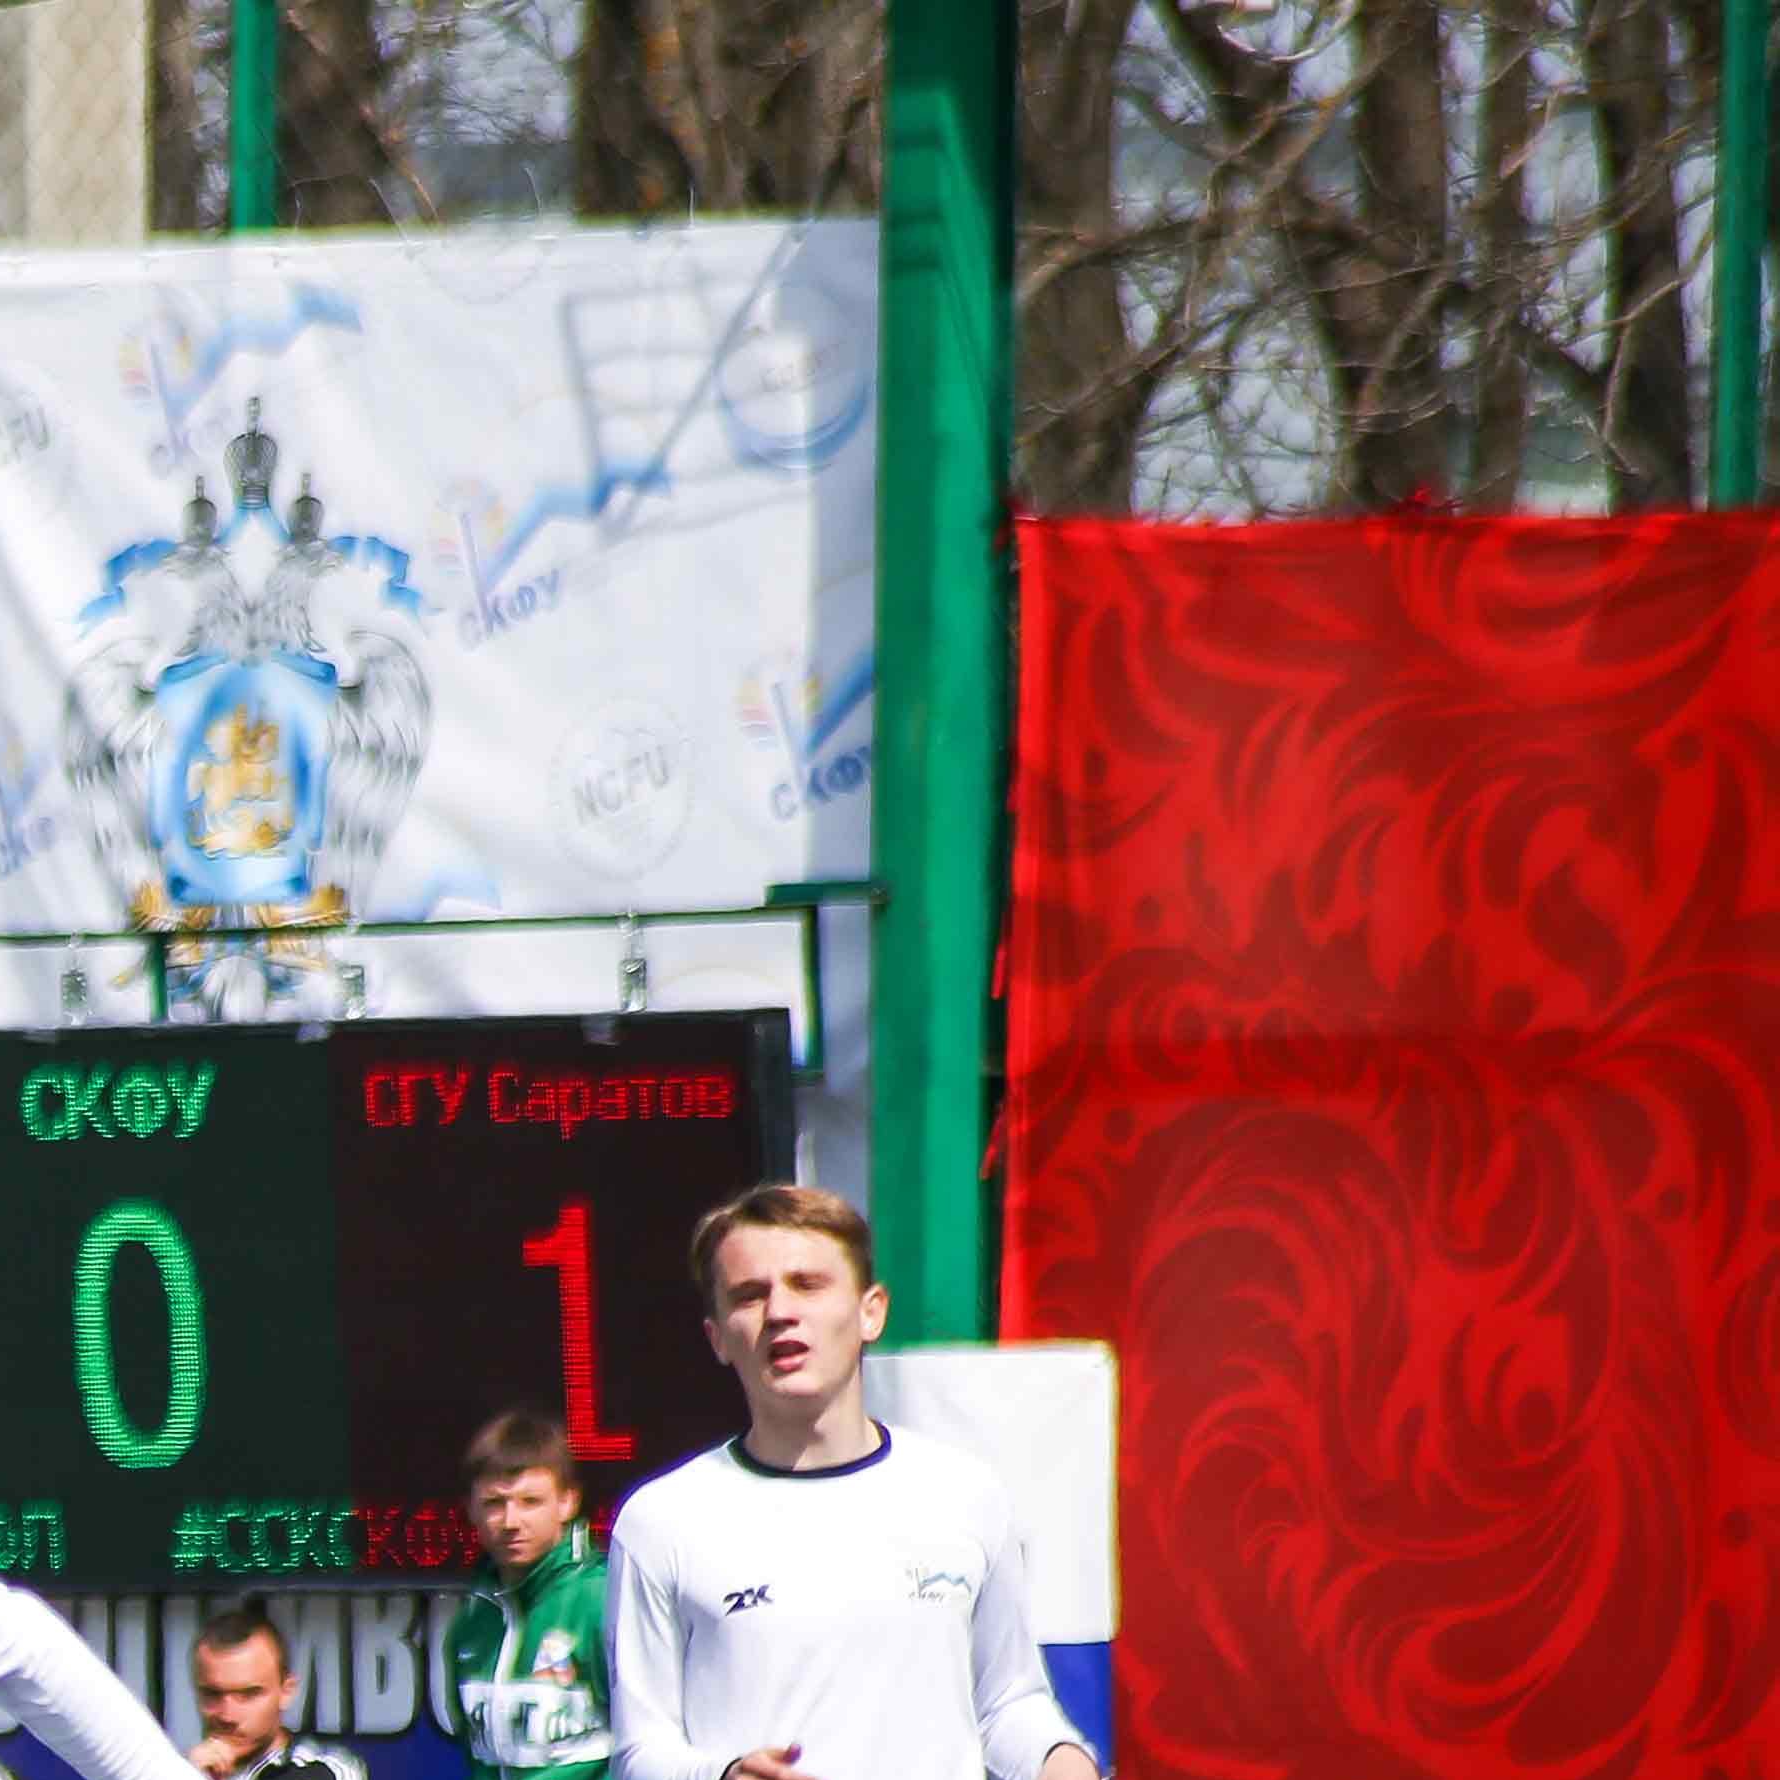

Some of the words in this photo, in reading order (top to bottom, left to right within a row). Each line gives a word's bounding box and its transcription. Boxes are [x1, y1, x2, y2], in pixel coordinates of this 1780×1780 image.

[571, 744, 671, 825] NCFU
[19, 1062, 219, 1142] СКФУ
[365, 1064, 468, 1128] СГУ
[486, 1068, 737, 1142] Саратов
[72, 1203, 207, 1469] 0
[521, 1203, 634, 1462] 1
